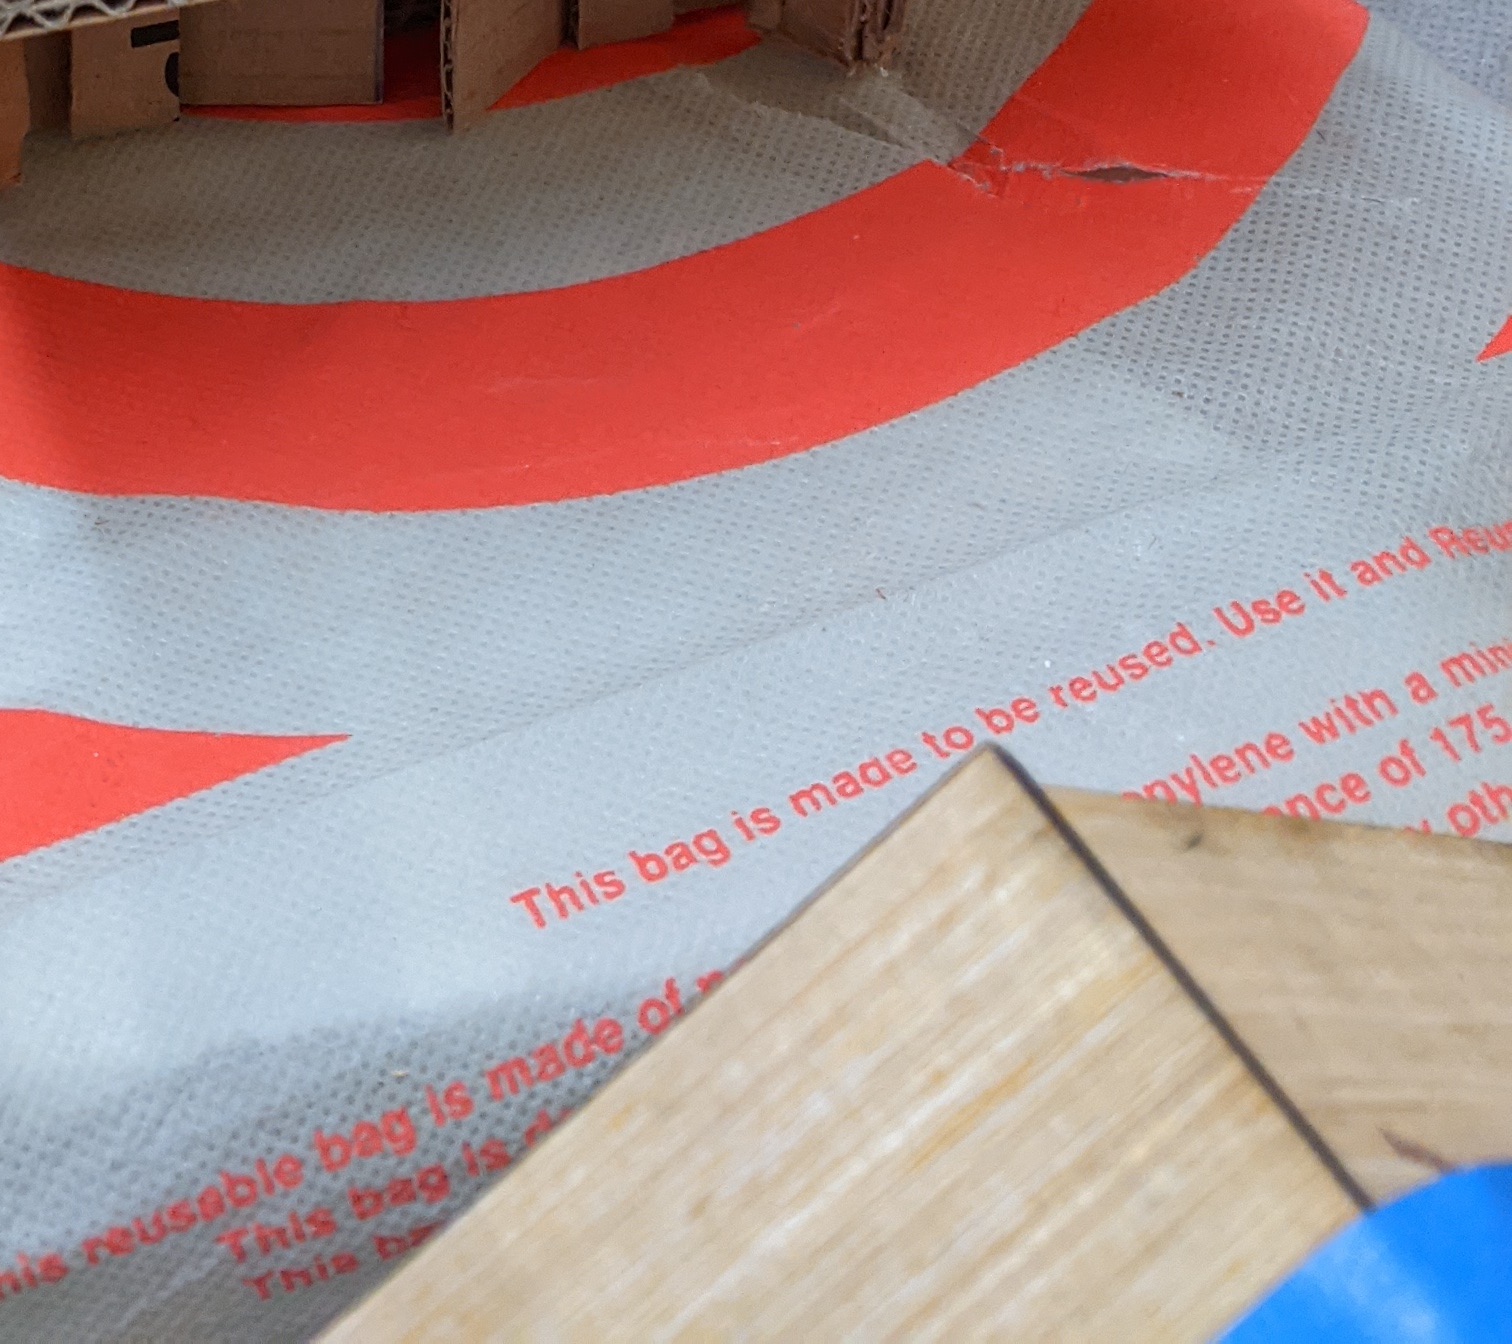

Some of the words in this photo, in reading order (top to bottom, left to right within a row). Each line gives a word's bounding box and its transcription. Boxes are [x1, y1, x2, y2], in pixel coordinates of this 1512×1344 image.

[509, 870, 626, 929] This
[628, 828, 731, 883] bag
[730, 806, 781, 842] is
[788, 749, 918, 817] made
[920, 725, 975, 759] to
[974, 697, 1040, 735] be
[1048, 622, 1217, 709] reused.
[1213, 588, 1306, 637] Use
[1304, 569, 1347, 602] it
[1349, 536, 1431, 587] and
[1298, 688, 1399, 746] with
[1403, 670, 1438, 705] a
[1377, 738, 1428, 788] of
[1430, 703, 1512, 762] 175
[82, 1154, 303, 1265] reusable
[312, 1107, 417, 1173] bag
[424, 1081, 474, 1127] is
[484, 1018, 624, 1102] made
[637, 977, 685, 1035] of
[216, 1208, 337, 1263] This
[347, 1165, 450, 1220] bag
[462, 1140, 512, 1177] is
